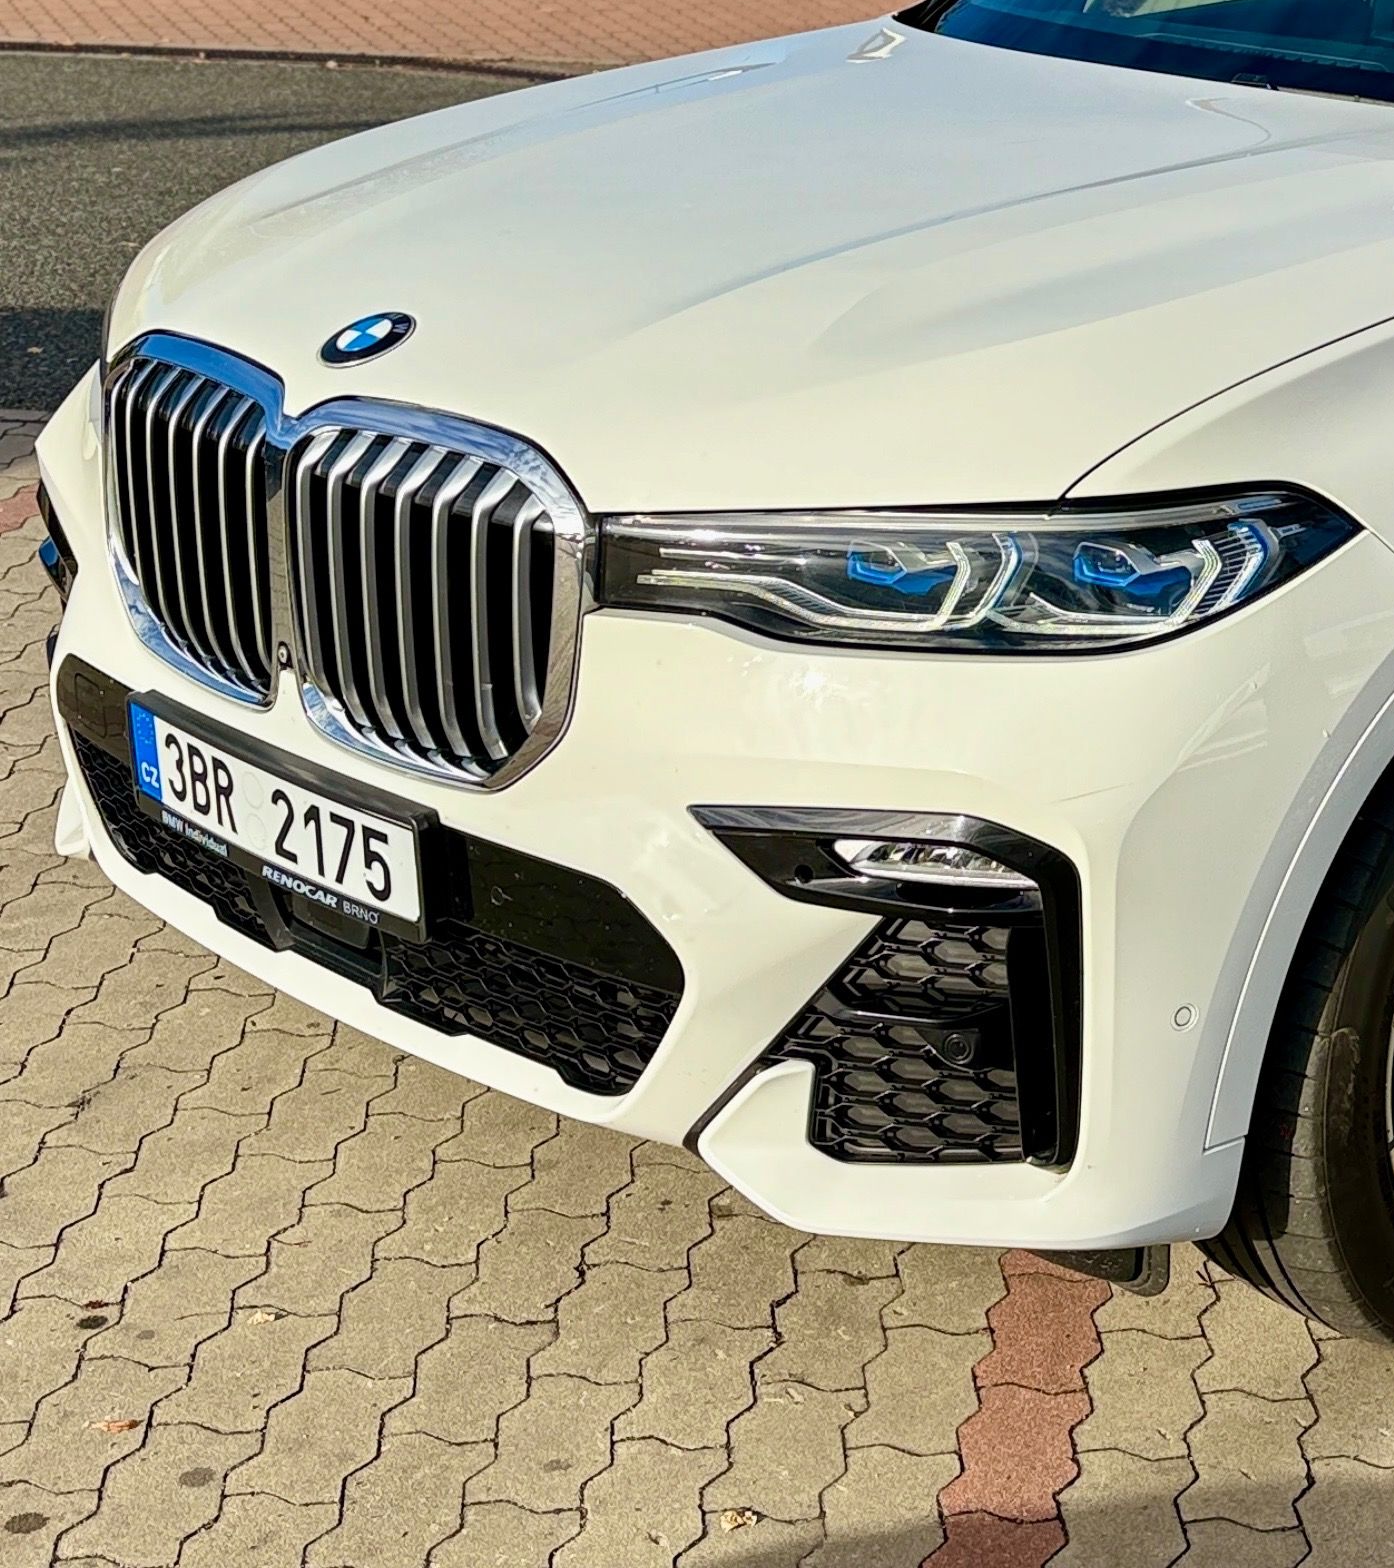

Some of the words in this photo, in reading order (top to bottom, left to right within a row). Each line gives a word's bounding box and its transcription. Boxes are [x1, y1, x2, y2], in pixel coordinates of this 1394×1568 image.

[141, 761, 160, 789] CZ
[162, 810, 184, 832] BMW
[165, 733, 238, 835] 3BR
[271, 789, 392, 901] 2175
[262, 865, 338, 908] RENOCAR
[343, 900, 380, 925] BRNO
